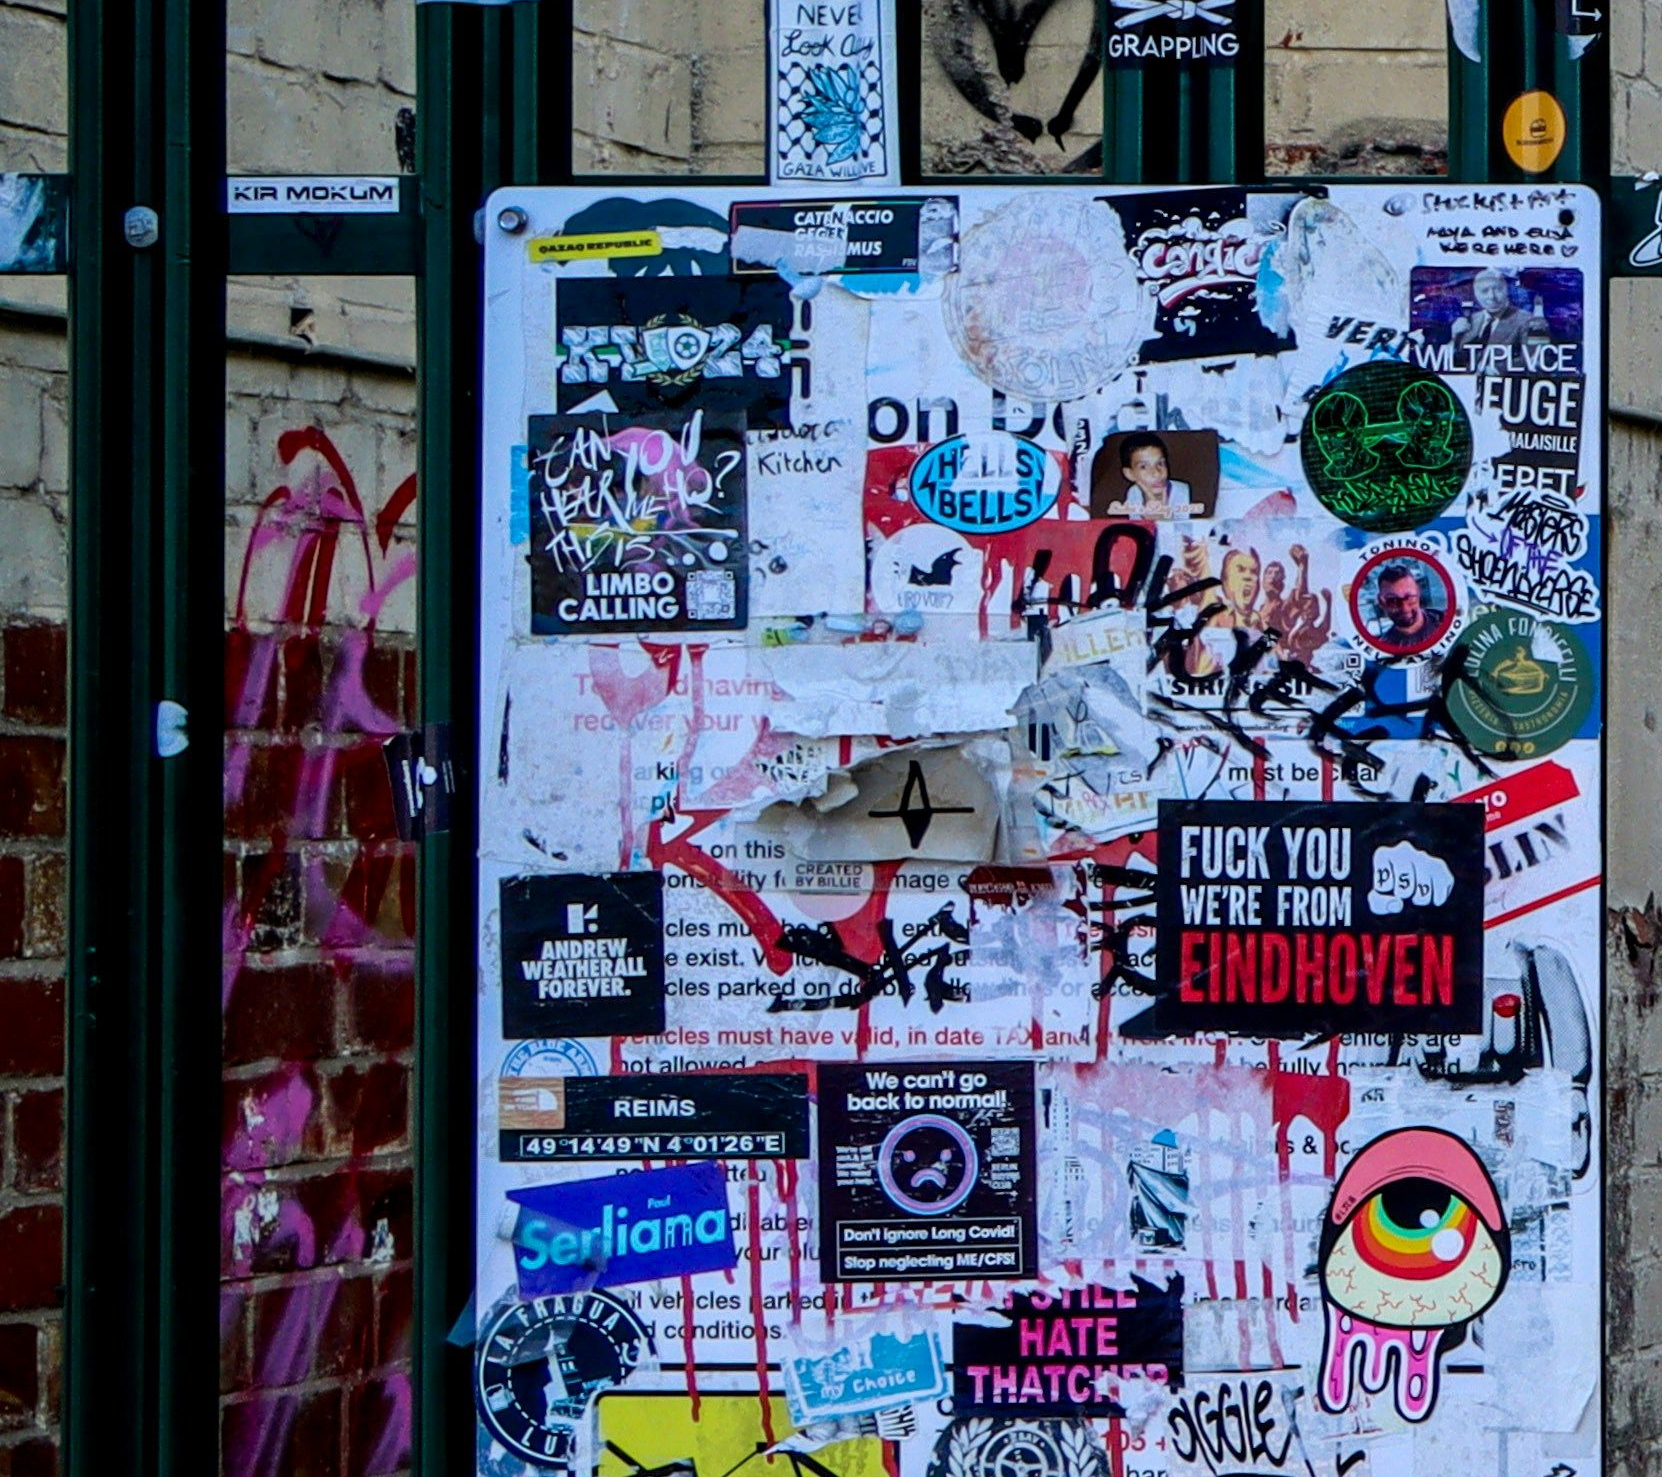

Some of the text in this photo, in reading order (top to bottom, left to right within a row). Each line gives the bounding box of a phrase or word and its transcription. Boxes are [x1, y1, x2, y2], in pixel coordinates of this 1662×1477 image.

[1108, 33, 1239, 59] GRAPPLING
[233, 184, 394, 201] KIR MOKUM
[758, 452, 842, 476] Kitchen
[937, 489, 1033, 524] BELLS
[586, 572, 675, 596] LIMBO
[558, 597, 679, 622] CALLING
[1291, 763, 1319, 783] be
[711, 839, 785, 860] on this
[1180, 826, 1352, 881] FUCK YOU
[795, 864, 863, 877] CREATED
[796, 876, 862, 888] BY BILLIE
[1180, 884, 1352, 927] WE'RE FROM
[542, 938, 628, 959] ANDREW
[522, 957, 647, 978] WEATHERALL
[1180, 931, 1454, 1006] EINDHOVEN
[538, 976, 632, 998] FOREVER.
[717, 977, 797, 999] parked
[718, 1026, 984, 1048] must have in date
[866, 1071, 987, 1092] We can't go
[614, 1099, 697, 1117] REIMS
[847, 1090, 1007, 1111] back to normal!
[844, 1225, 1015, 1243] Don't ignore Long Covid!
[844, 1252, 1015, 1271] Stop neglecting ME/CFS!
[1020, 1318, 1119, 1357] HATE
[852, 1369, 917, 1394] Choice
